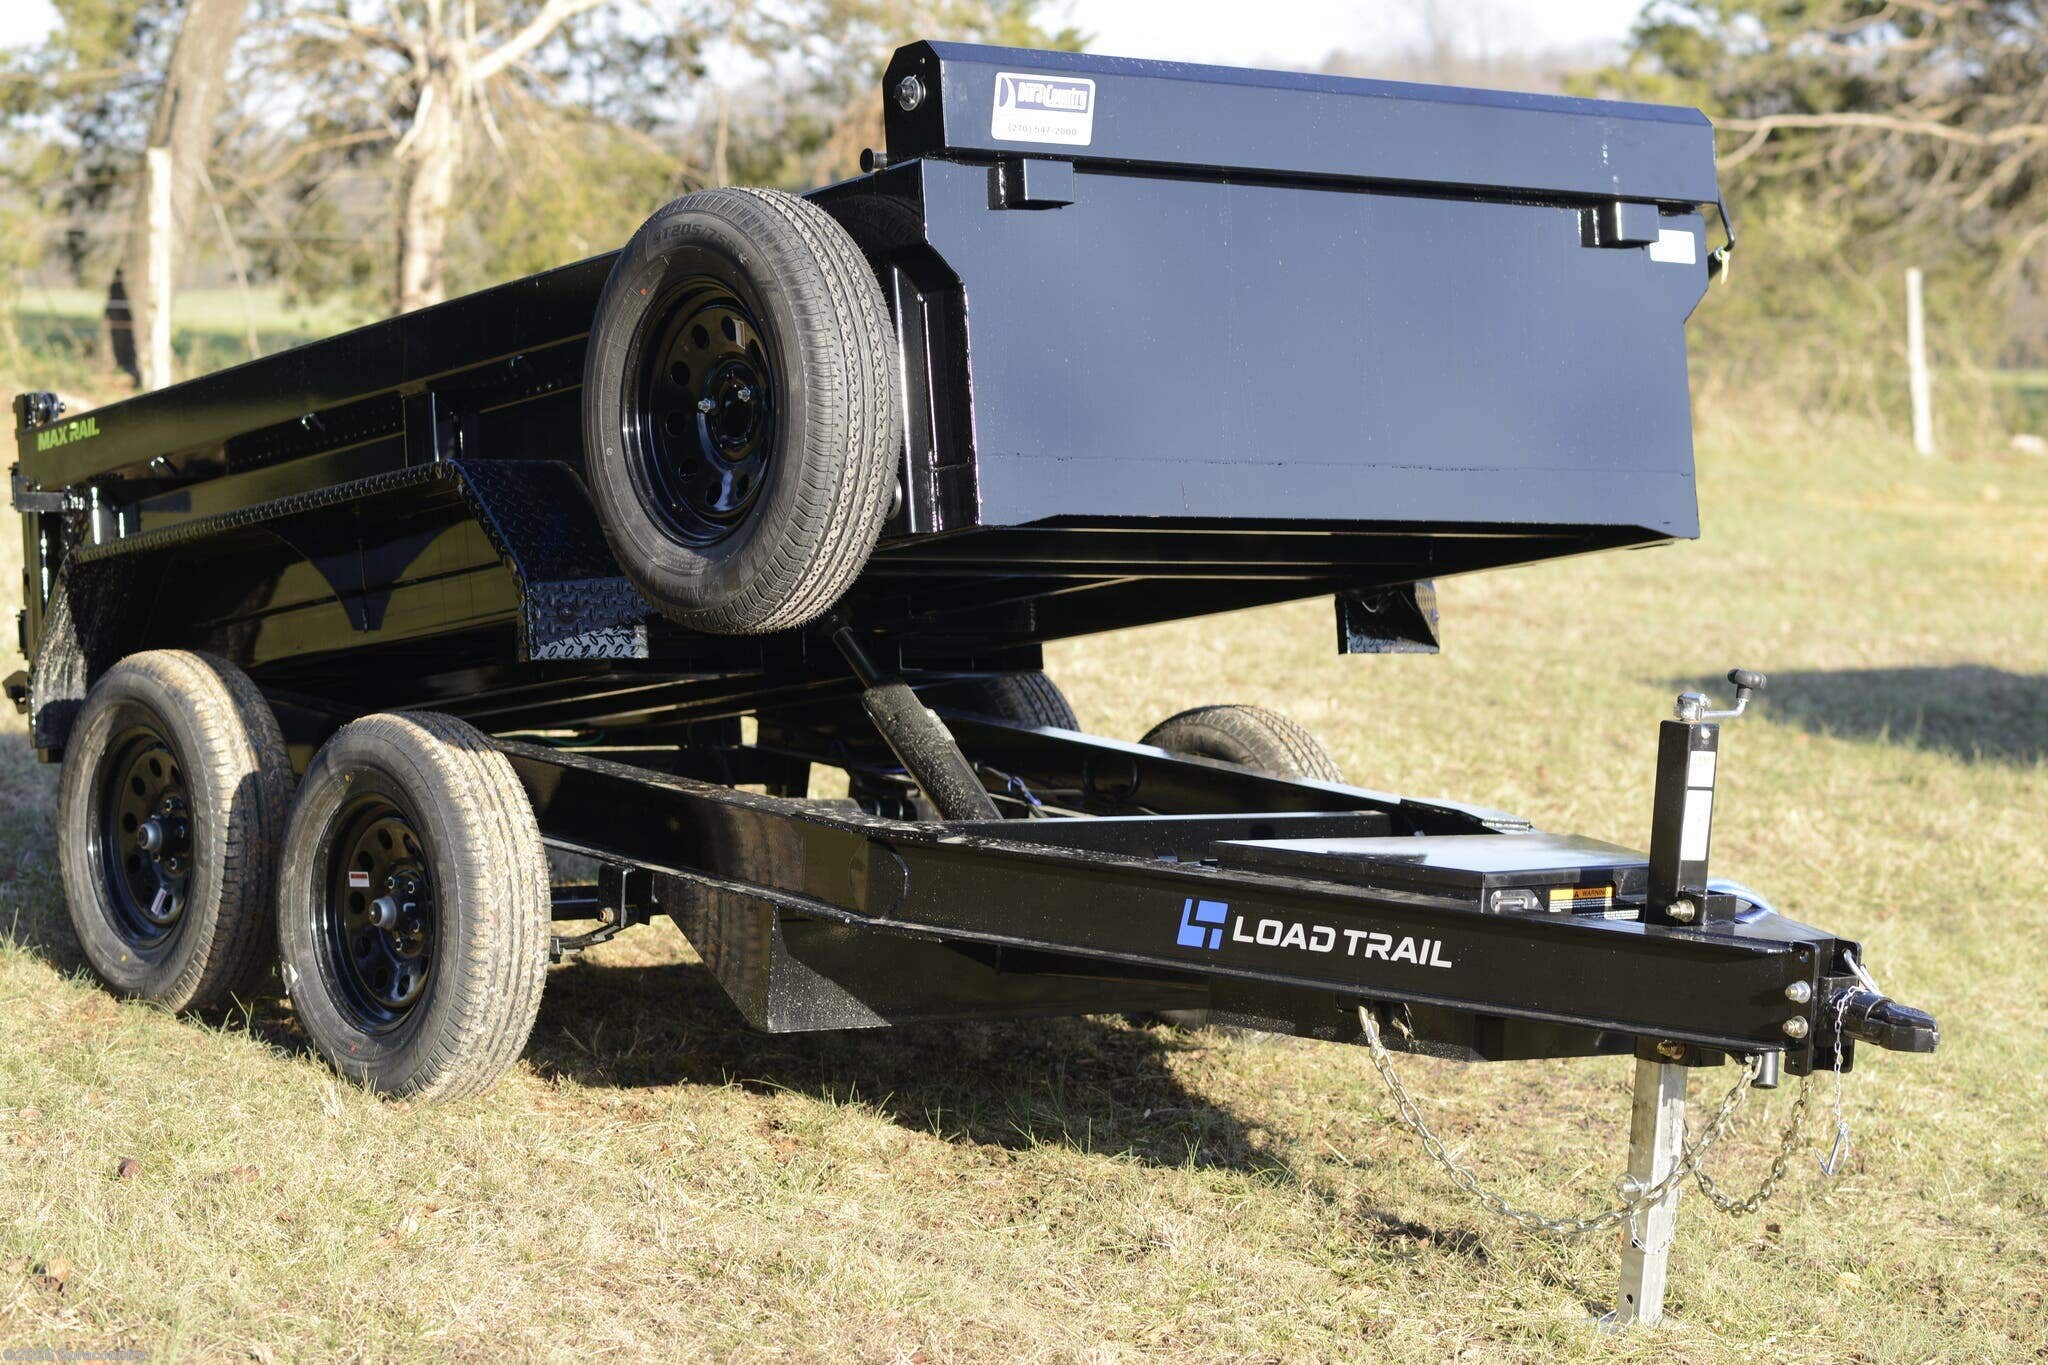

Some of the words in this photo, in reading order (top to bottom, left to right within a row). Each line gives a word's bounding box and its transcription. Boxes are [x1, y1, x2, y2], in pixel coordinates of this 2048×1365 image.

[37, 427, 68, 452] MAX
[69, 417, 100, 442] RAIL
[1232, 916, 1336, 953] LOAD
[1343, 929, 1452, 968] TRAIL
